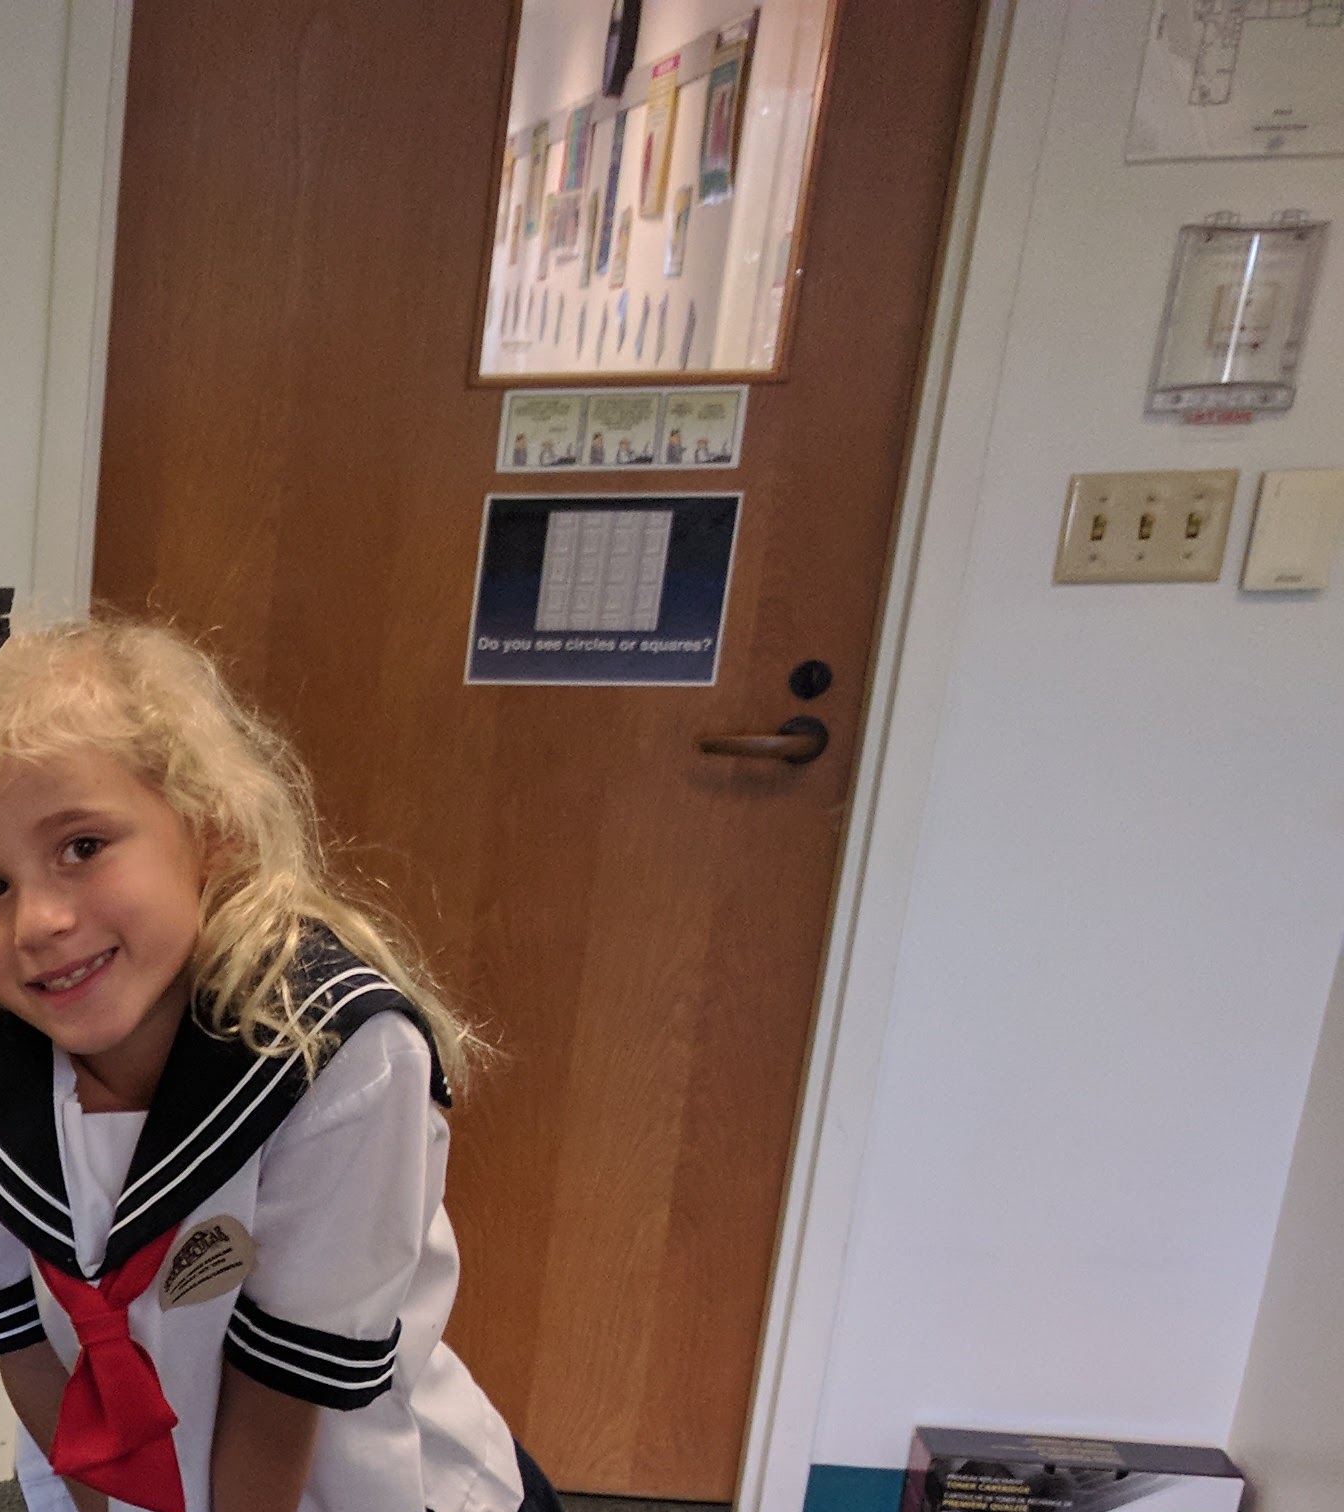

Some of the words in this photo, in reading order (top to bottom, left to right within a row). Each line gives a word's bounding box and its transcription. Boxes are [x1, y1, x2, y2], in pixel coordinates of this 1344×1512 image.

[477, 637, 499, 650] Do
[502, 639, 532, 654] you
[534, 640, 563, 651] see
[564, 637, 615, 651] circles
[618, 640, 636, 651] or
[639, 638, 712, 654] squares?
